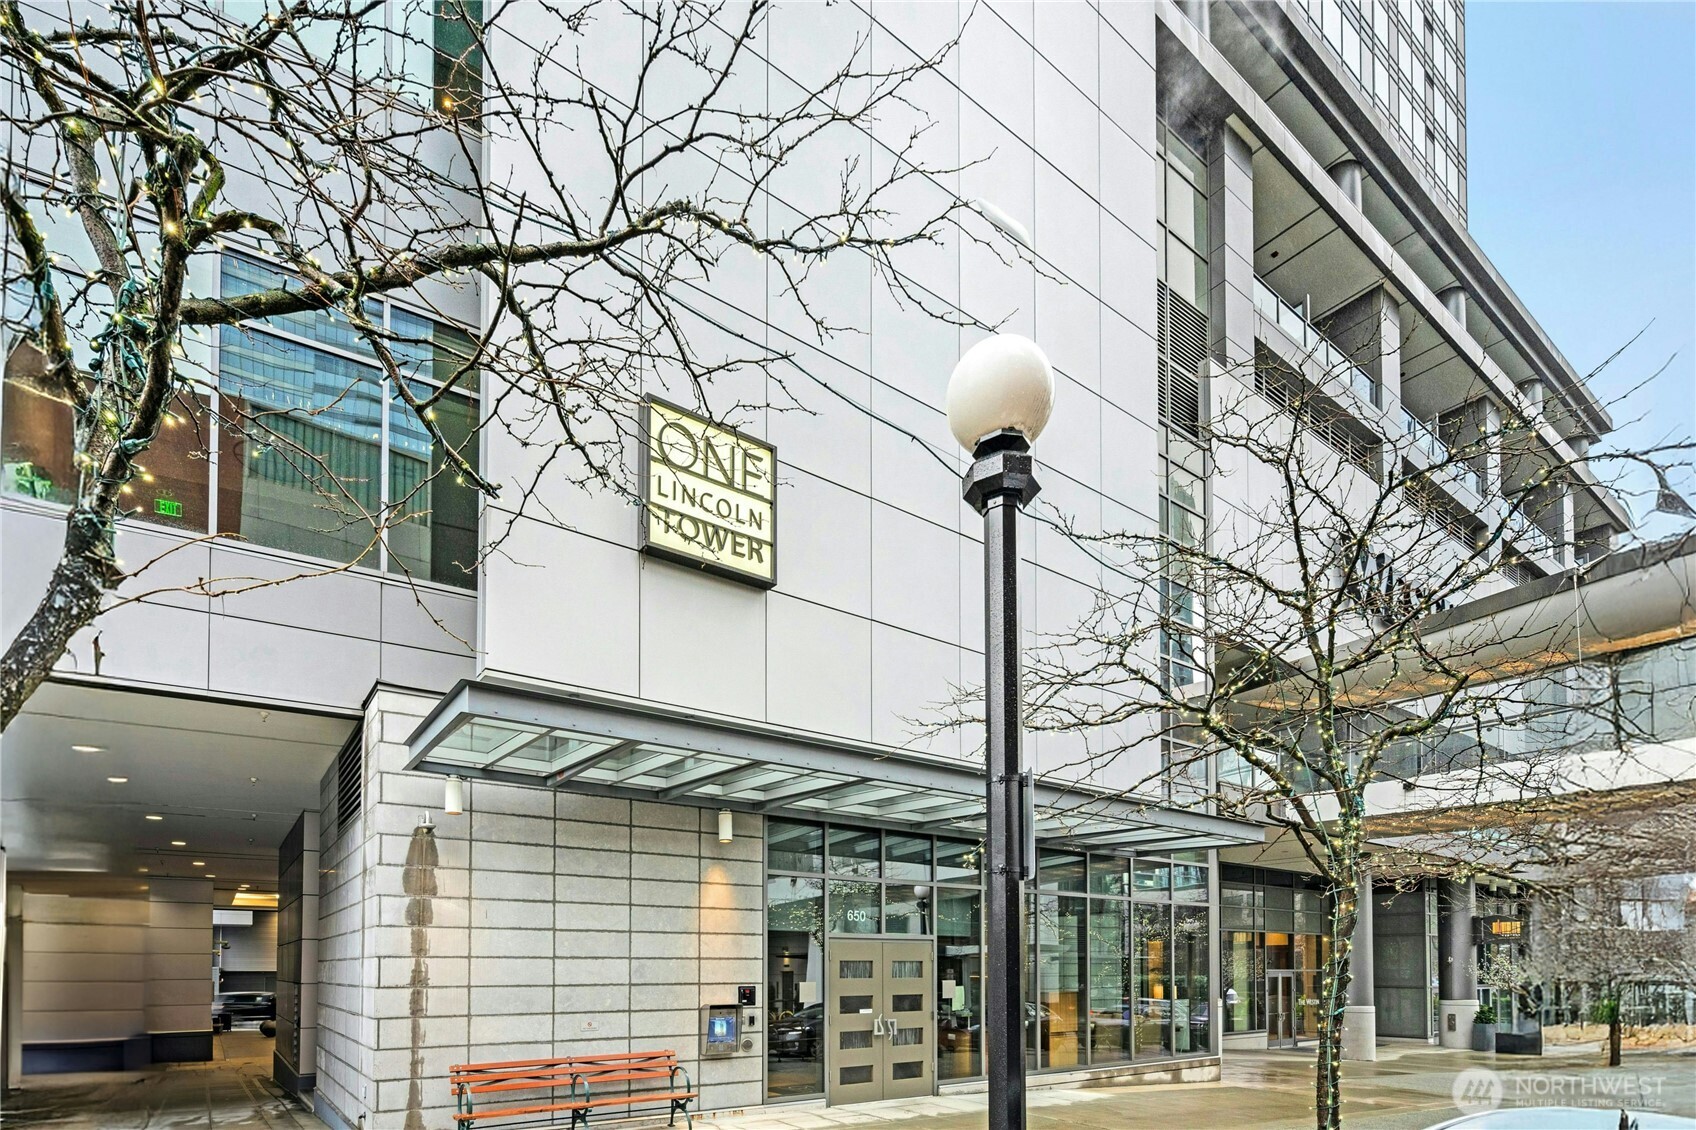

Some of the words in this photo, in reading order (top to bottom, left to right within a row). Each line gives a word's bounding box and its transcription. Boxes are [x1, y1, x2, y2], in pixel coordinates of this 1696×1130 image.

[657, 422, 764, 493] ONE
[160, 500, 178, 515] EXIT
[657, 475, 763, 531] LINCOLN
[657, 508, 764, 564] TOWER
[847, 910, 866, 922] 650
